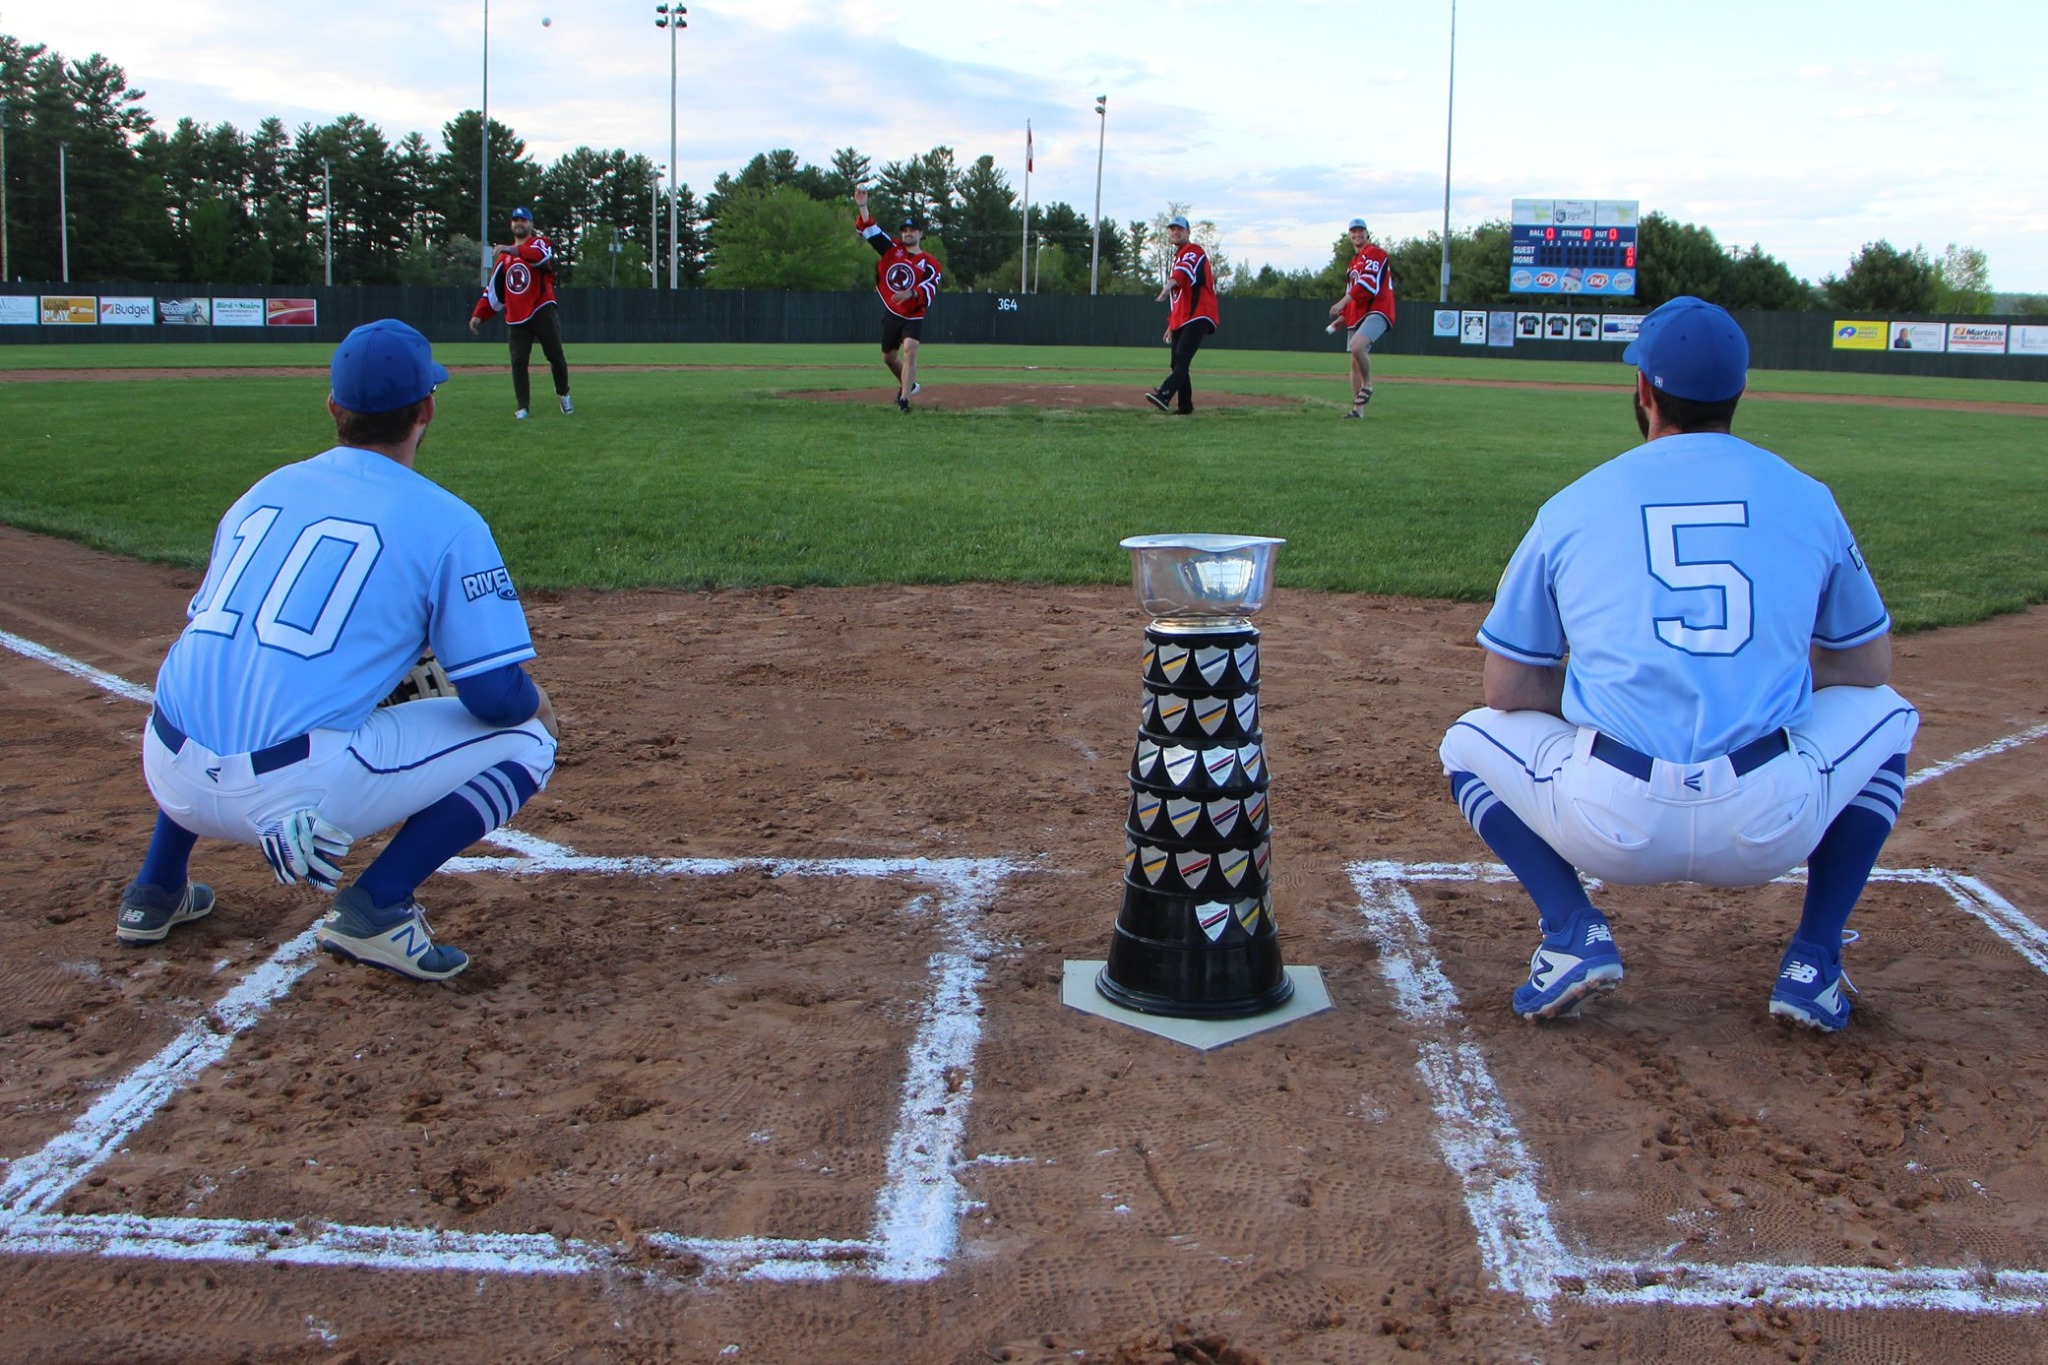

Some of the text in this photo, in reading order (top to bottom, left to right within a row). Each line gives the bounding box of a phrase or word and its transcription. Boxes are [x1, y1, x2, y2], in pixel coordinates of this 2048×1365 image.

[1546, 228, 1555, 240] 0
[1583, 228, 1592, 240] 0
[1595, 230, 1608, 238] OUT
[1609, 228, 1617, 241] 0
[1513, 246, 1535, 254] GUEST
[1364, 259, 1380, 272] 26
[1512, 256, 1535, 264] HOME
[115, 303, 150, 318] Budget
[997, 298, 1018, 311] 364
[43, 309, 70, 322] PLAY
[1966, 328, 2003, 337] Martin's
[189, 504, 384, 661] 10
[1640, 500, 1754, 657] 5
[1585, 924, 1612, 947] NB
[1781, 961, 1818, 984] NB
